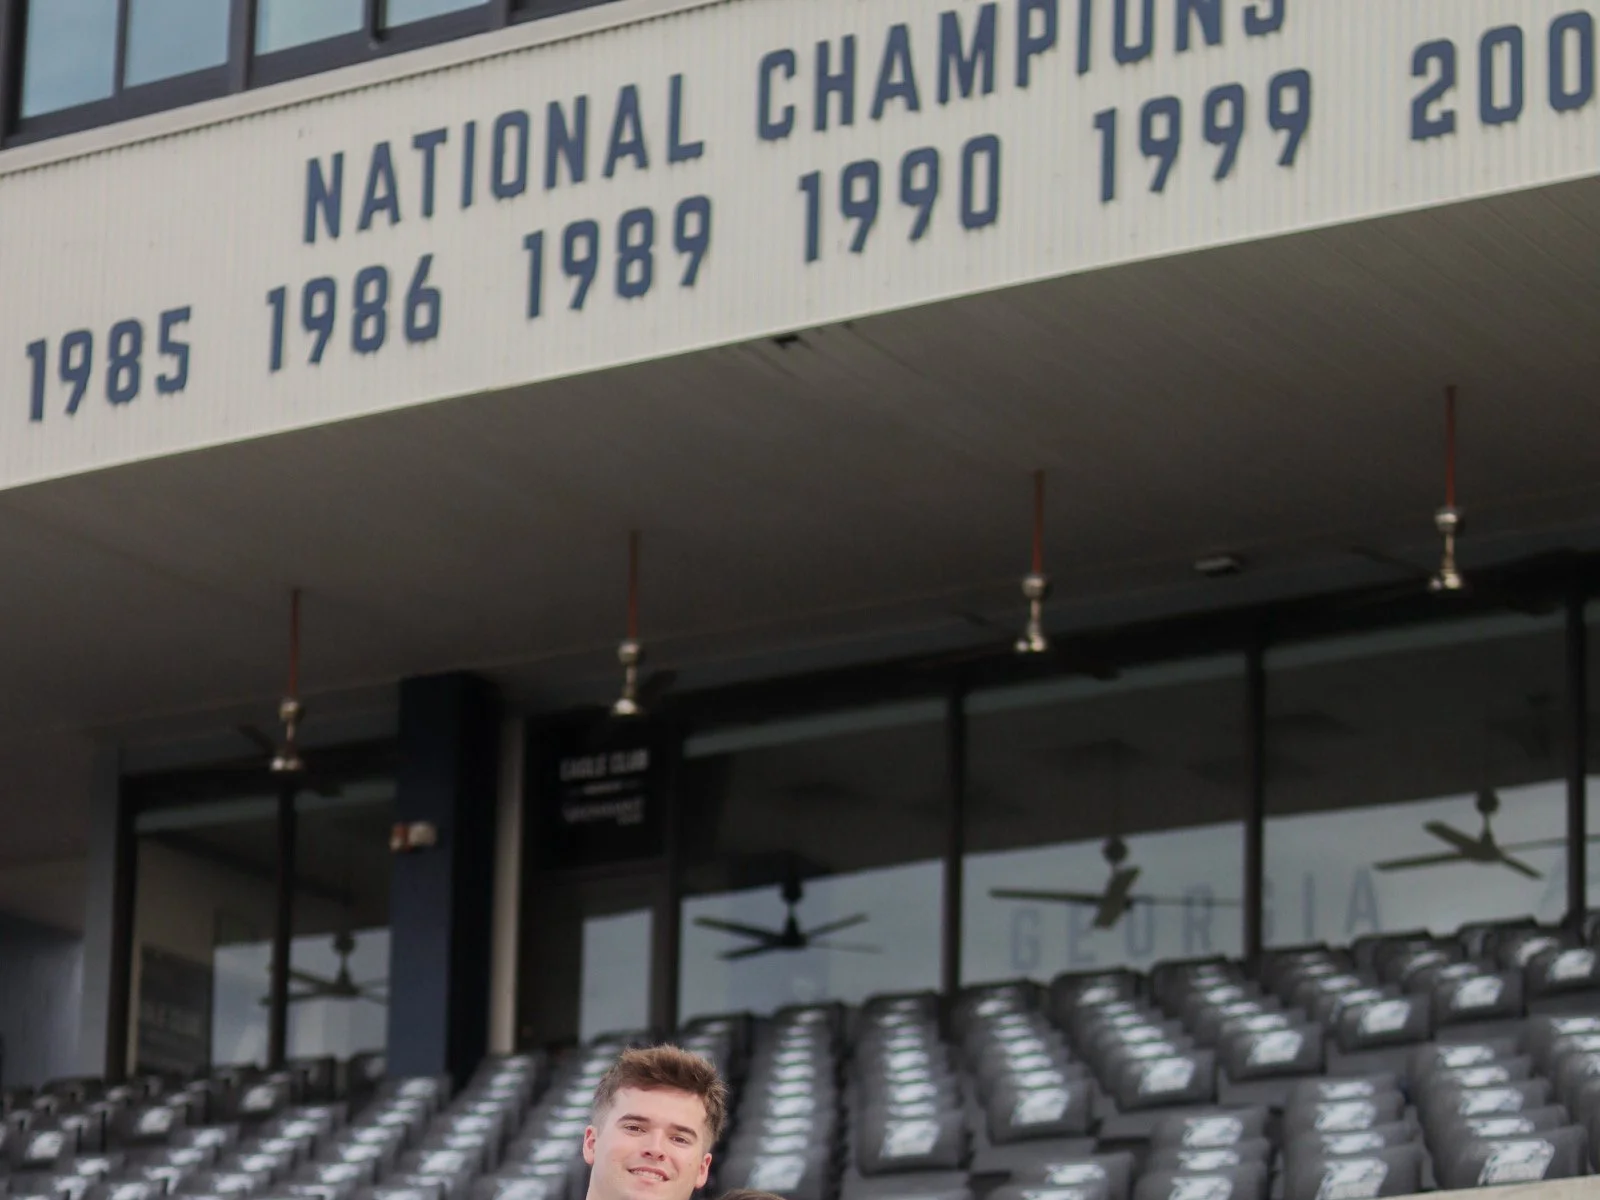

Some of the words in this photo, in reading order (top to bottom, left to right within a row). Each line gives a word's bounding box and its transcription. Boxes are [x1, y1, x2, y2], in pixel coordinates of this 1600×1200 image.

[26, 305, 192, 423] 1985
[267, 253, 442, 373] 1986
[523, 194, 712, 320] 1989
[798, 133, 1001, 264] 1990
[1092, 68, 1313, 205] 1999
[303, 73, 705, 245] NATIONAL
